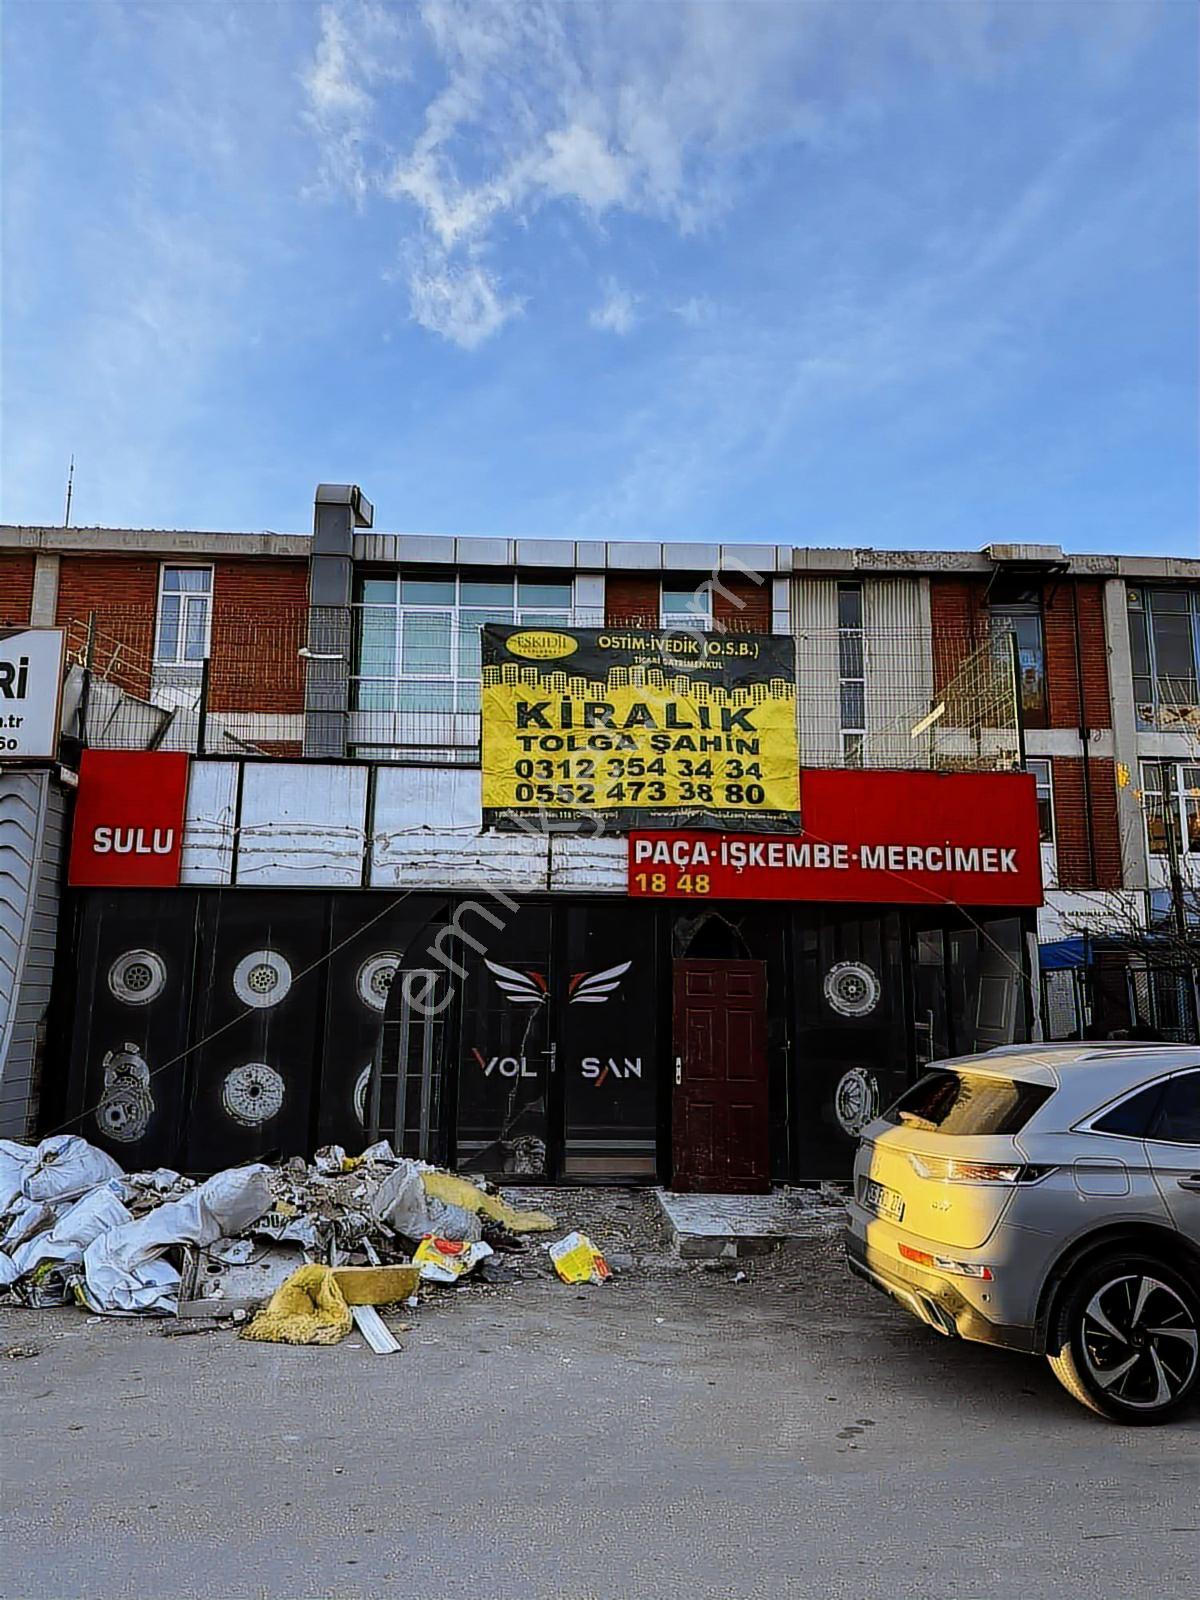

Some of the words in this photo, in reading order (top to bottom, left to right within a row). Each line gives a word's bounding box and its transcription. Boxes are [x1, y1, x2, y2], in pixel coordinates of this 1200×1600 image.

[598, 633, 699, 654] OSTİM-İVEDİK
[704, 641, 759, 660] (O.S.B.)
[516, 695, 758, 732] KİRALIK
[515, 733, 639, 752] TOLGA
[650, 734, 760, 755] ŞAHİN
[515, 758, 595, 779] 0312
[607, 757, 667, 777] 354
[677, 758, 714, 779] 34
[725, 758, 763, 780] 34
[515, 782, 595, 804] 0552
[606, 781, 667, 801] 473
[678, 781, 714, 802] 38
[725, 783, 765, 804] 80
[93, 827, 174, 853] SULU
[635, 873, 667, 893] 18
[677, 874, 711, 894] 48
